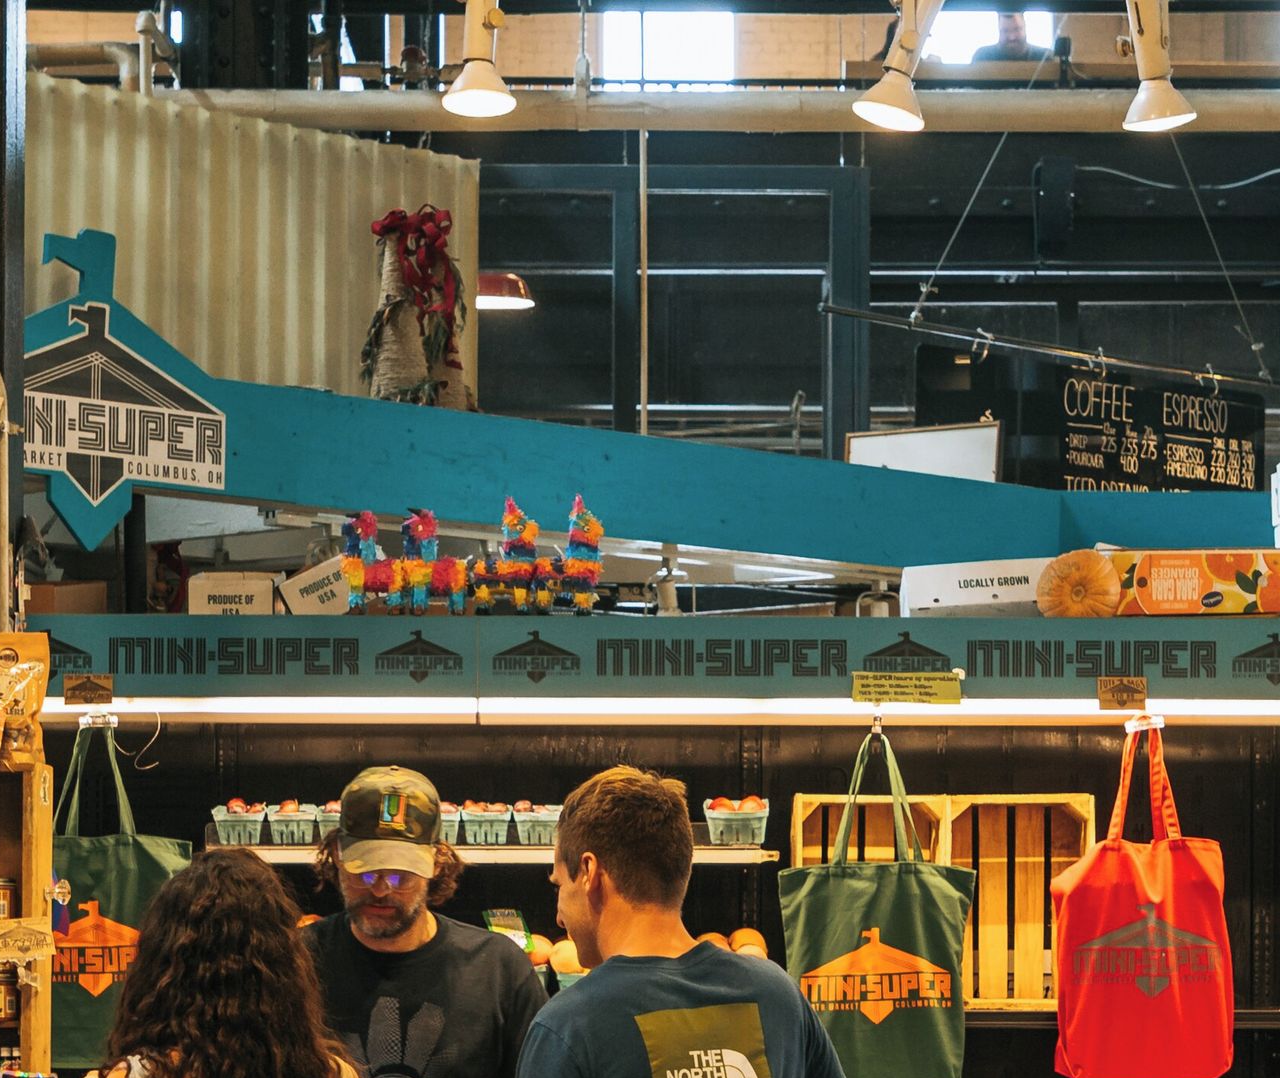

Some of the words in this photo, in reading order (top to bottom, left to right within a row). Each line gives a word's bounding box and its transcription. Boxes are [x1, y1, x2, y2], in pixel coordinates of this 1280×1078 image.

[1064, 378, 1135, 423] COFFEE
[1163, 392, 1228, 433] ESPRESSO
[24, 395, 222, 466] NI-SUPER
[24, 451, 63, 467] ARKET
[128, 461, 200, 482] COLUMBUS,
[208, 470, 222, 483] OH
[1167, 444, 1204, 465] ESPRESSO
[300, 575, 332, 598] PRODUCE
[332, 570, 343, 581] OF
[958, 577, 994, 588] LOCALLY
[997, 575, 1030, 587] GROWN
[208, 594, 243, 605] PRODUCE
[245, 594, 255, 604] OF
[318, 589, 337, 604] USA
[109, 638, 359, 675] MINI-SUPER
[375, 656, 463, 670] MINI-SUPER
[493, 656, 580, 670] MINI-SUPER
[597, 639, 847, 676] MINI-SUPER
[863, 656, 951, 672] MINI-SUPER
[967, 640, 1216, 678] MINI-SUPER
[53, 946, 136, 973] NI-SUP
[800, 973, 951, 1001] MINI-SUPER
[689, 1049, 722, 1068] THE
